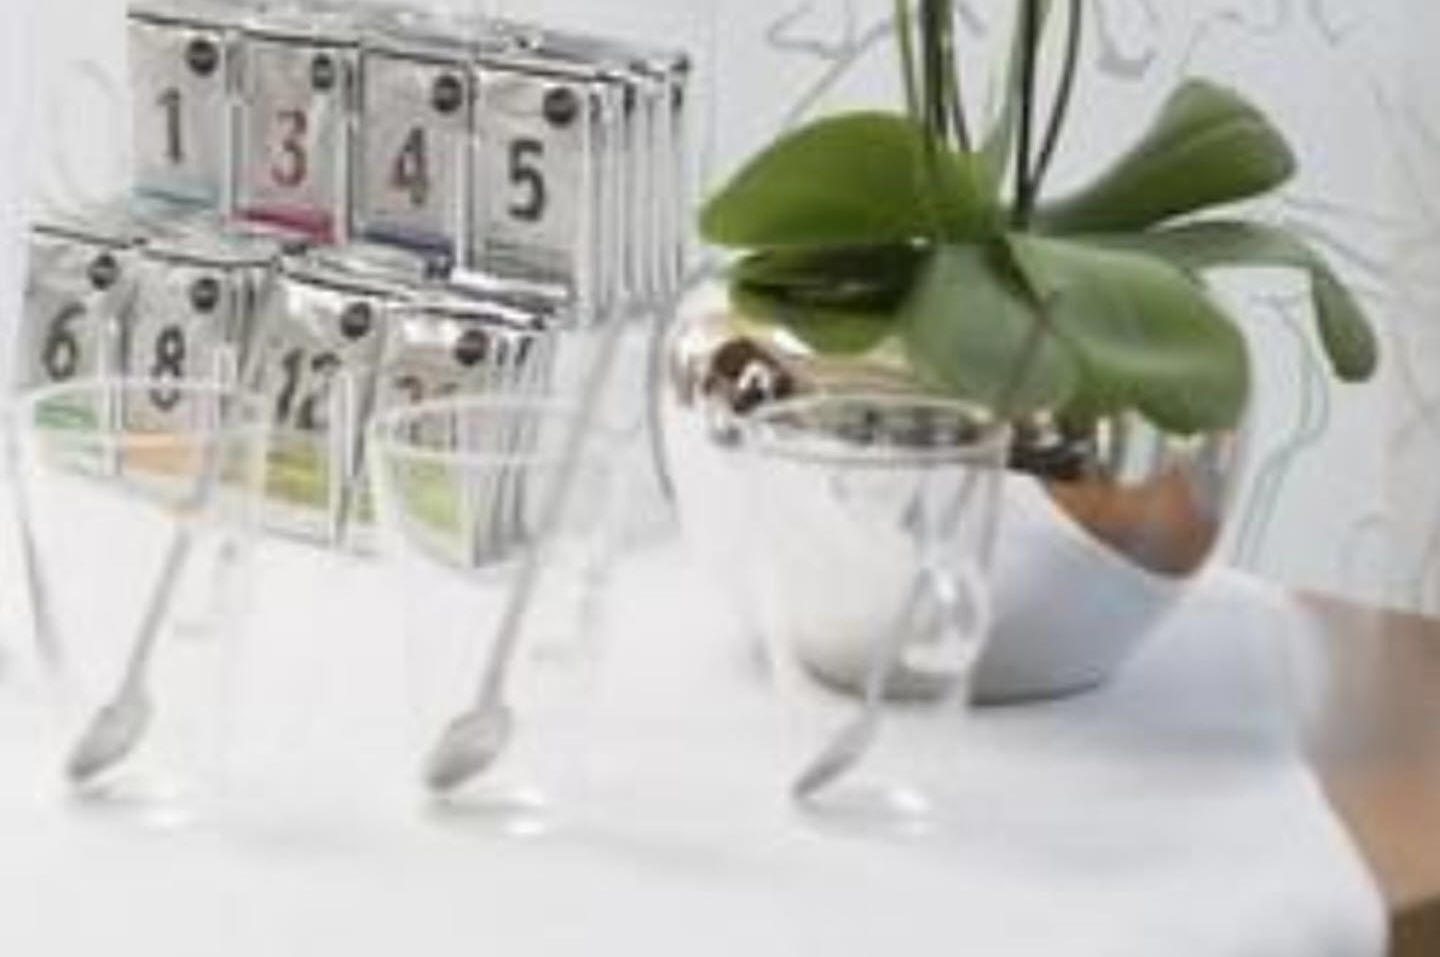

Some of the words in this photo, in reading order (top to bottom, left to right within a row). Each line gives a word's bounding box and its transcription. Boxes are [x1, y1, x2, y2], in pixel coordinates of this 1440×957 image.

[157, 88, 183, 164] 1
[271, 109, 308, 188] 3
[392, 126, 427, 207] 4
[509, 138, 544, 221] 5
[42, 302, 86, 383] 6
[150, 326, 186, 412] 8
